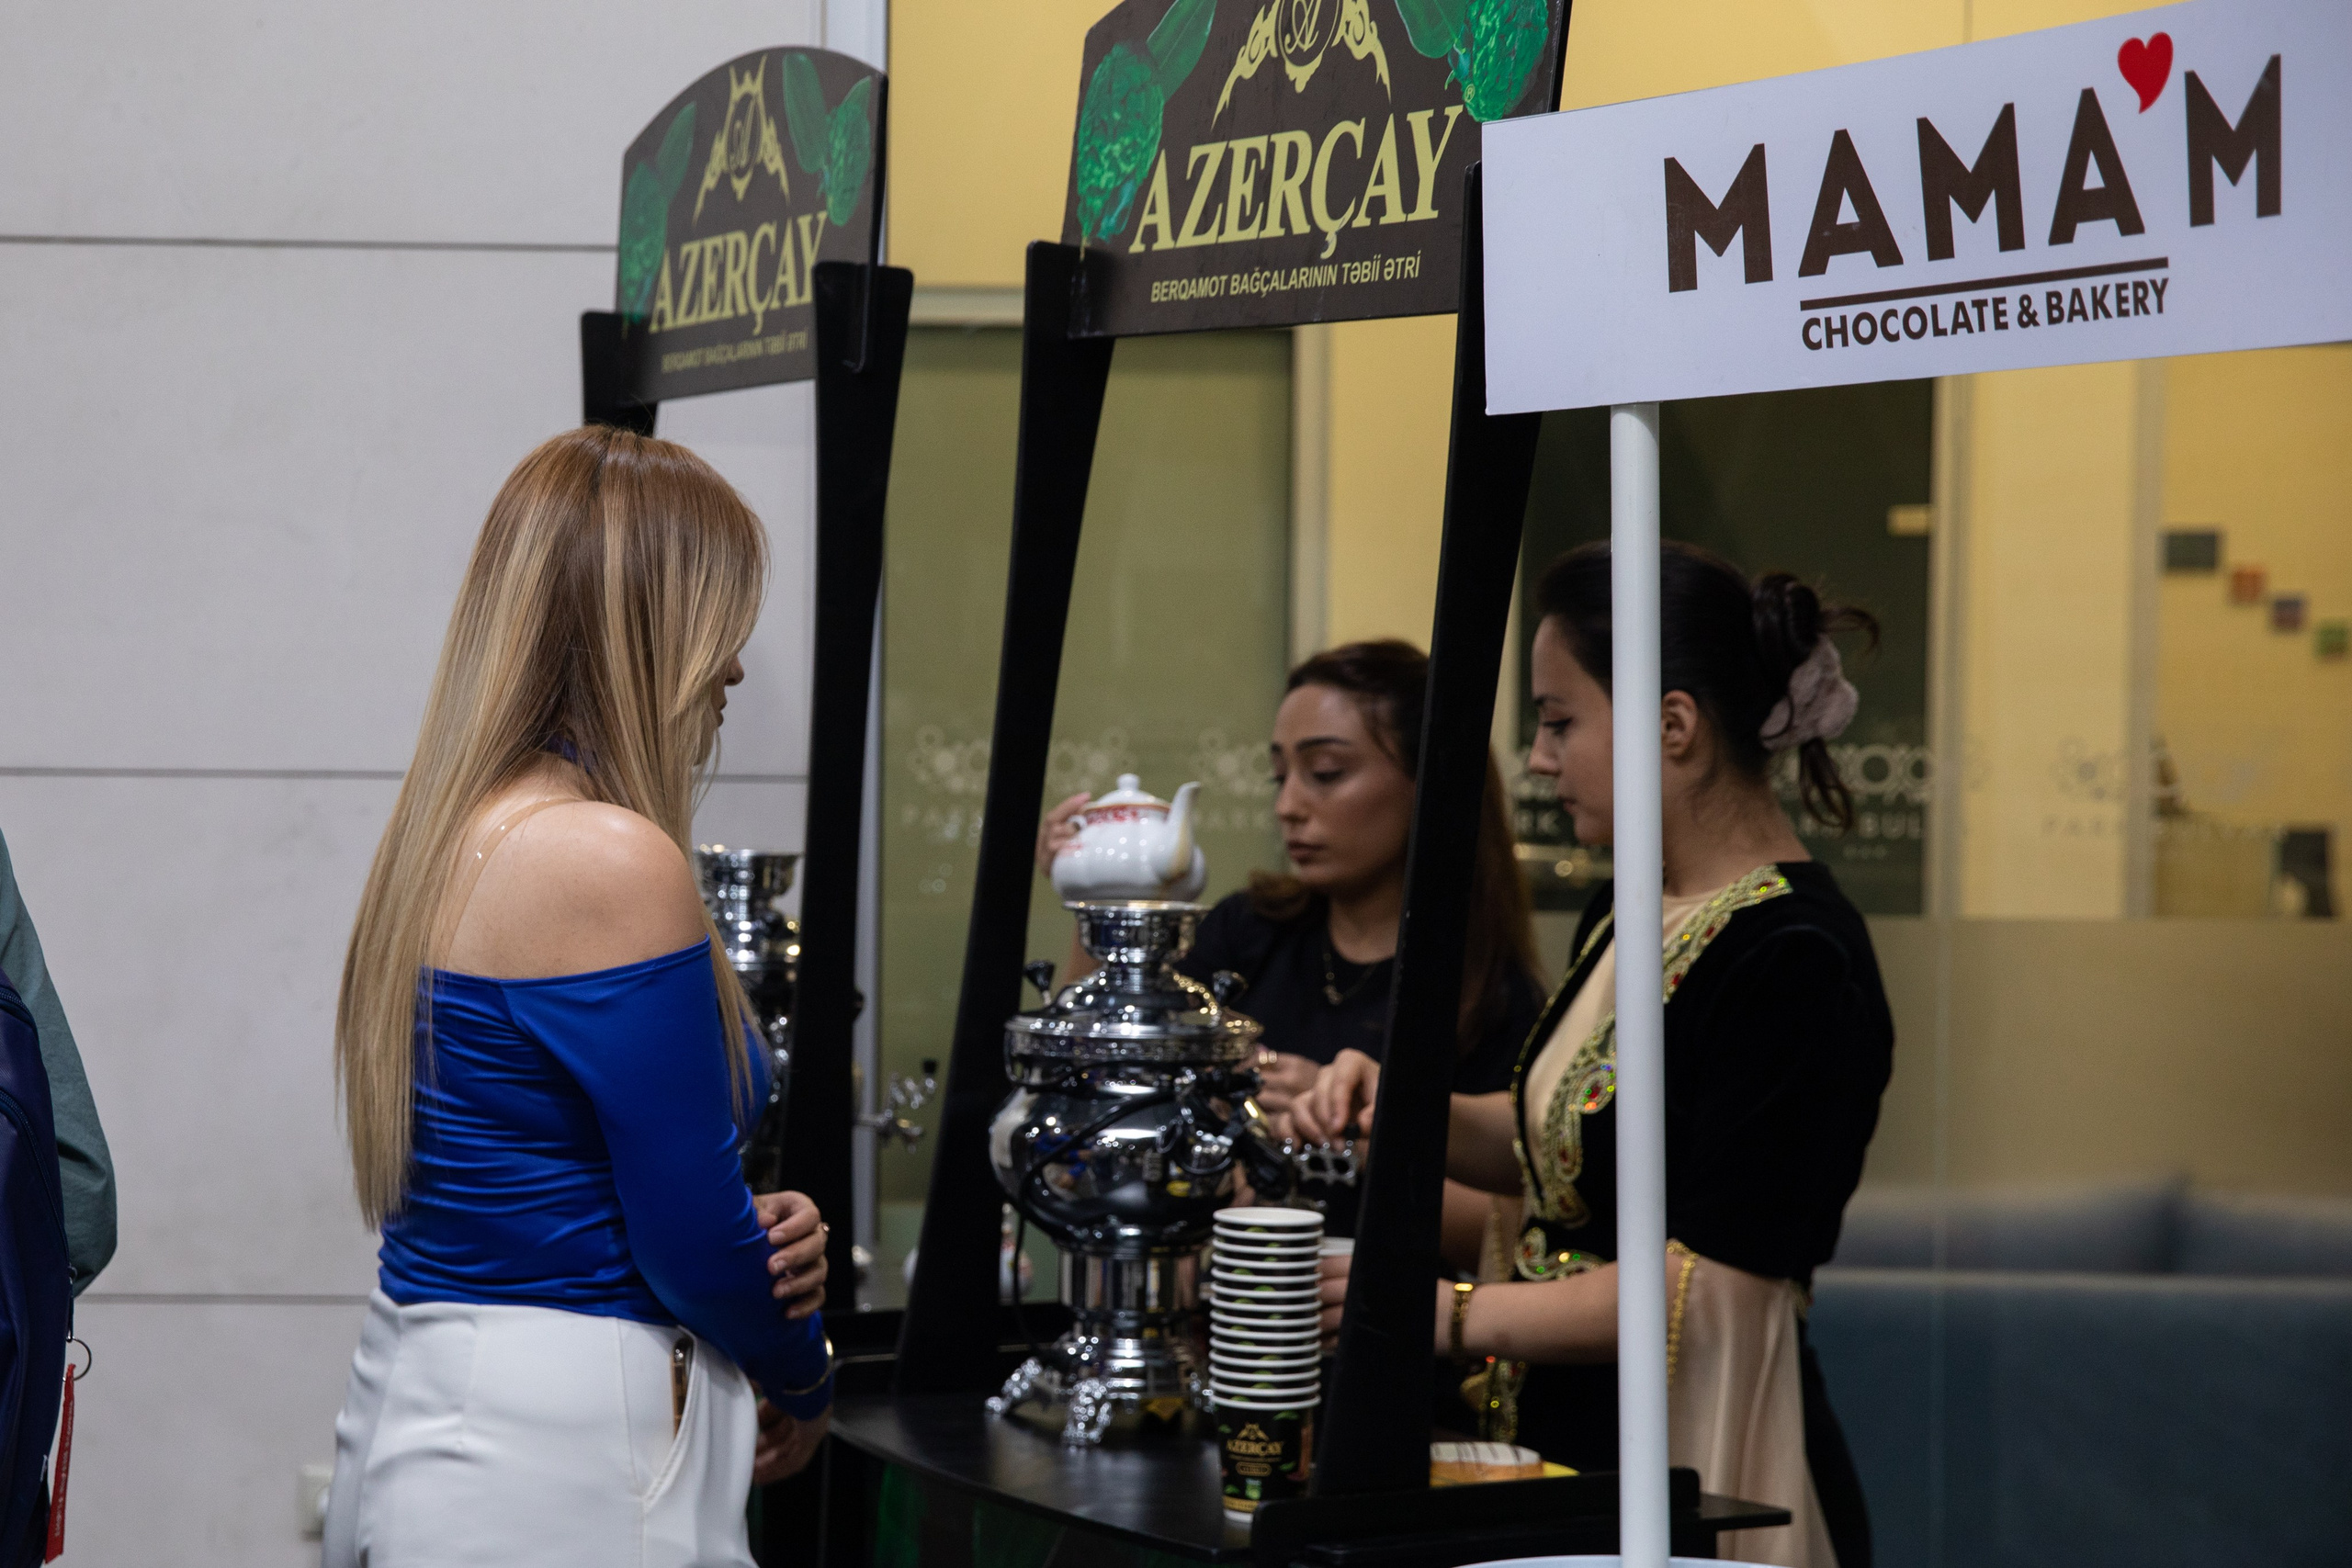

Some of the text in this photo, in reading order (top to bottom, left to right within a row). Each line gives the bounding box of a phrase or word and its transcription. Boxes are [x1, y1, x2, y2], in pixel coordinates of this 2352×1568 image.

[1128, 105, 1464, 258] AZERÇAY
[649, 210, 828, 335] AZERÇAY
[1150, 276, 1227, 302] BERQAMOT
[1229, 263, 1338, 298] BAĞÇALARININ
[1384, 250, 1421, 281] ƏTRİ
[1802, 277, 2169, 351] CHOCOLATE & BAKERY
